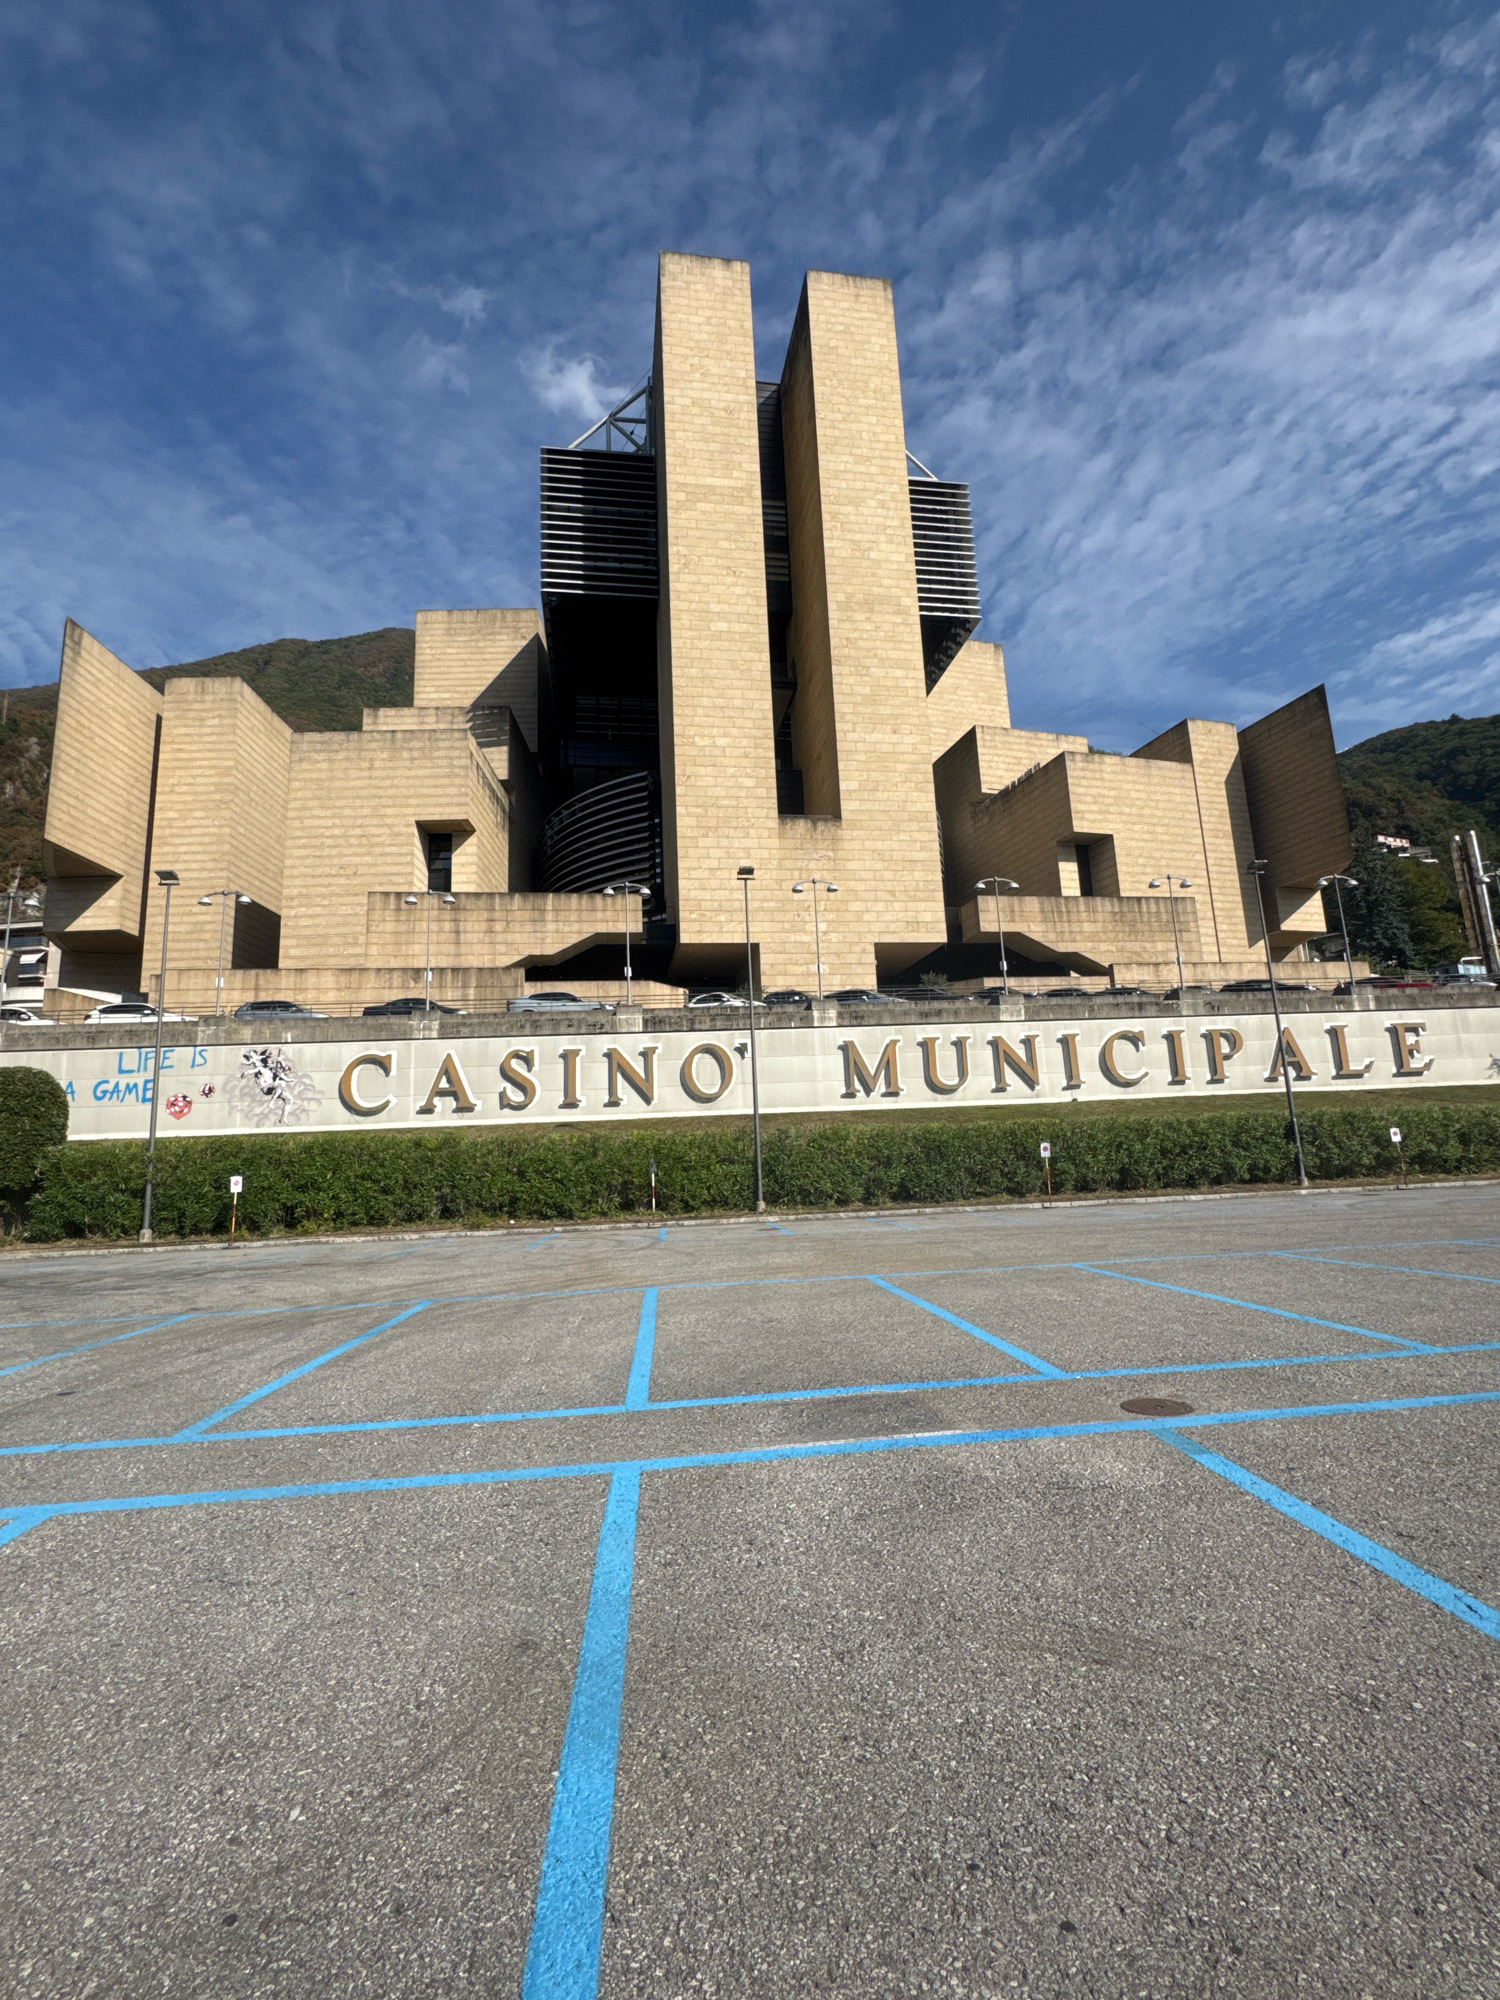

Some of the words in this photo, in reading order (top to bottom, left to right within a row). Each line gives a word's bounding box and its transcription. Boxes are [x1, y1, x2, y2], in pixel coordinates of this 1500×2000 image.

[117, 1047, 175, 1075] LIFE
[838, 1020, 1434, 1098] MUNICIPALE
[64, 1080, 76, 1102] A
[92, 1079, 154, 1104] GAME
